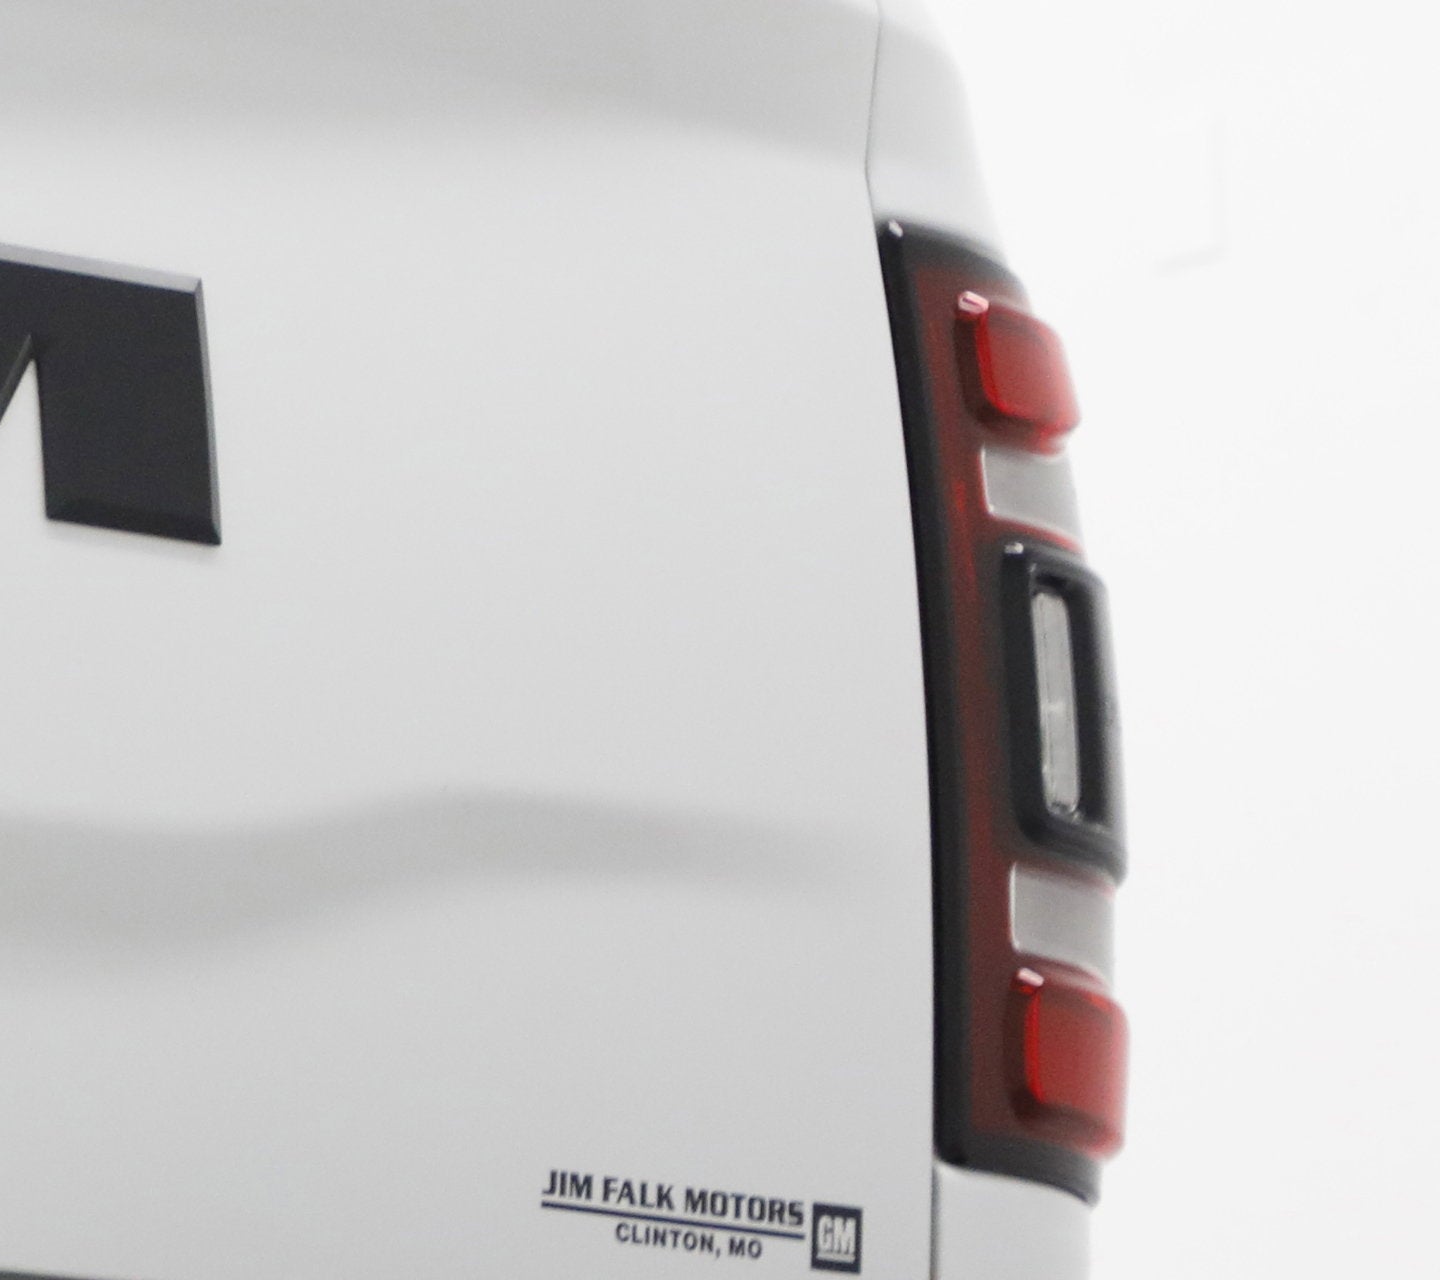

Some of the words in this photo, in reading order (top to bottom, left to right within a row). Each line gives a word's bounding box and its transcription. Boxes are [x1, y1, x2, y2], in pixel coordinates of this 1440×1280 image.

[542, 1170, 594, 1200] JIM
[602, 1177, 675, 1211] FALK
[684, 1187, 805, 1227] MOTORS
[615, 1222, 721, 1260] CLINTON,
[728, 1238, 763, 1259] MO
[816, 1215, 856, 1255] GM
